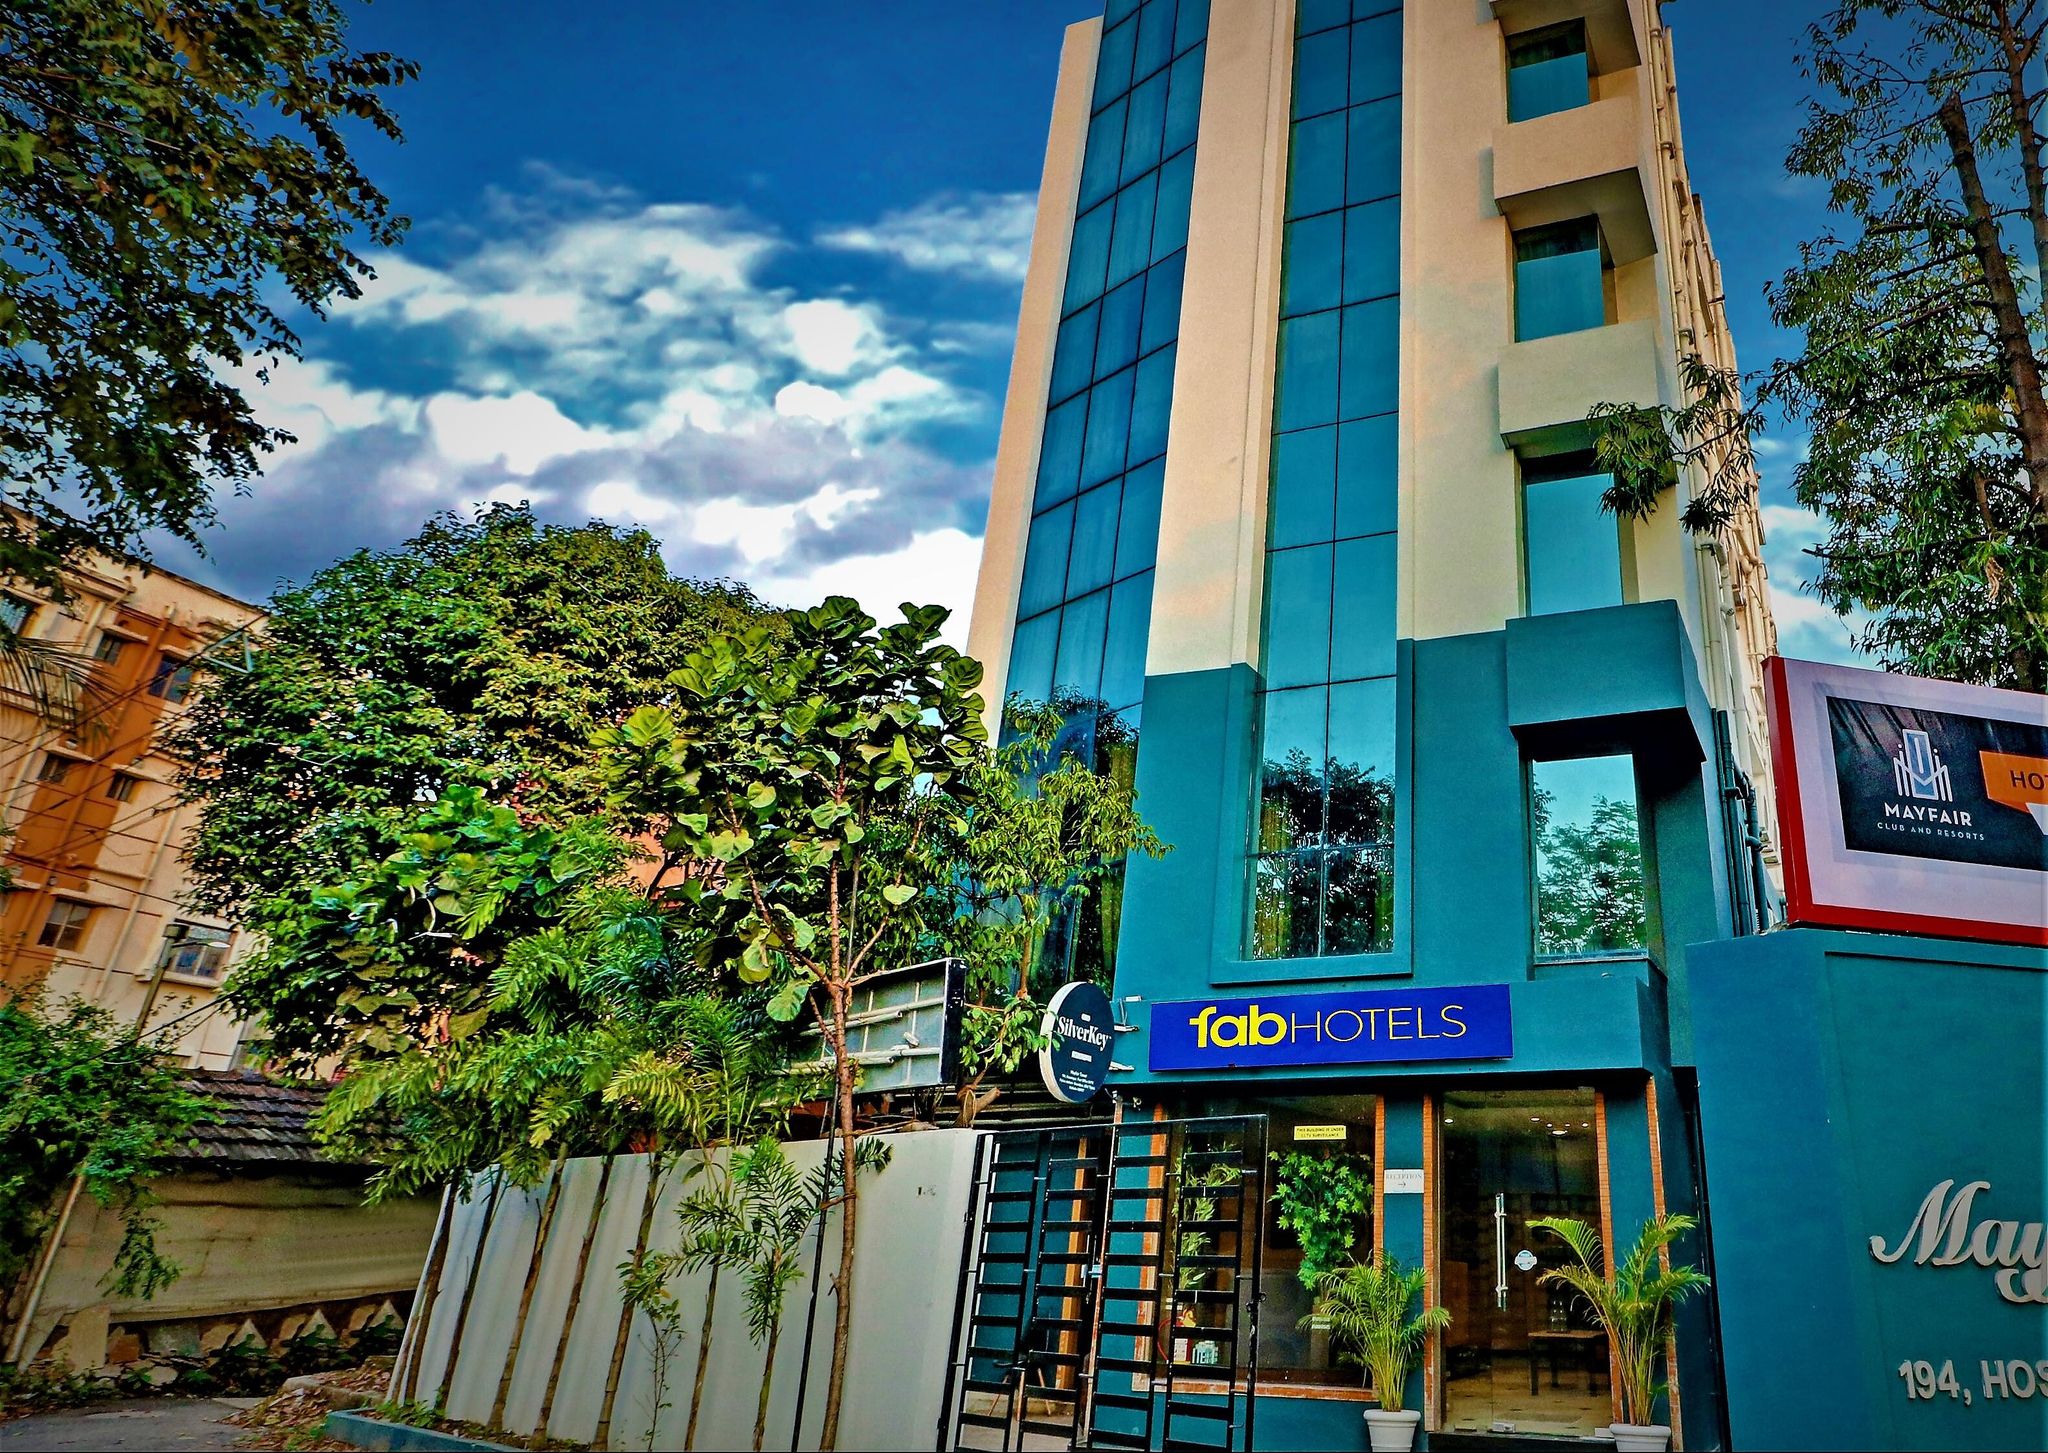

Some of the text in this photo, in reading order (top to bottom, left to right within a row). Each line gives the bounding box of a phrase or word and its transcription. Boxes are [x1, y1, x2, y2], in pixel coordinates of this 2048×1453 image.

[1884, 801, 1973, 827] MAYFAIR
[1877, 821, 1985, 841] CLUB AND RESORTS
[1057, 1015, 1109, 1052] SilverKey
[1898, 1359, 1972, 1406] 194,
